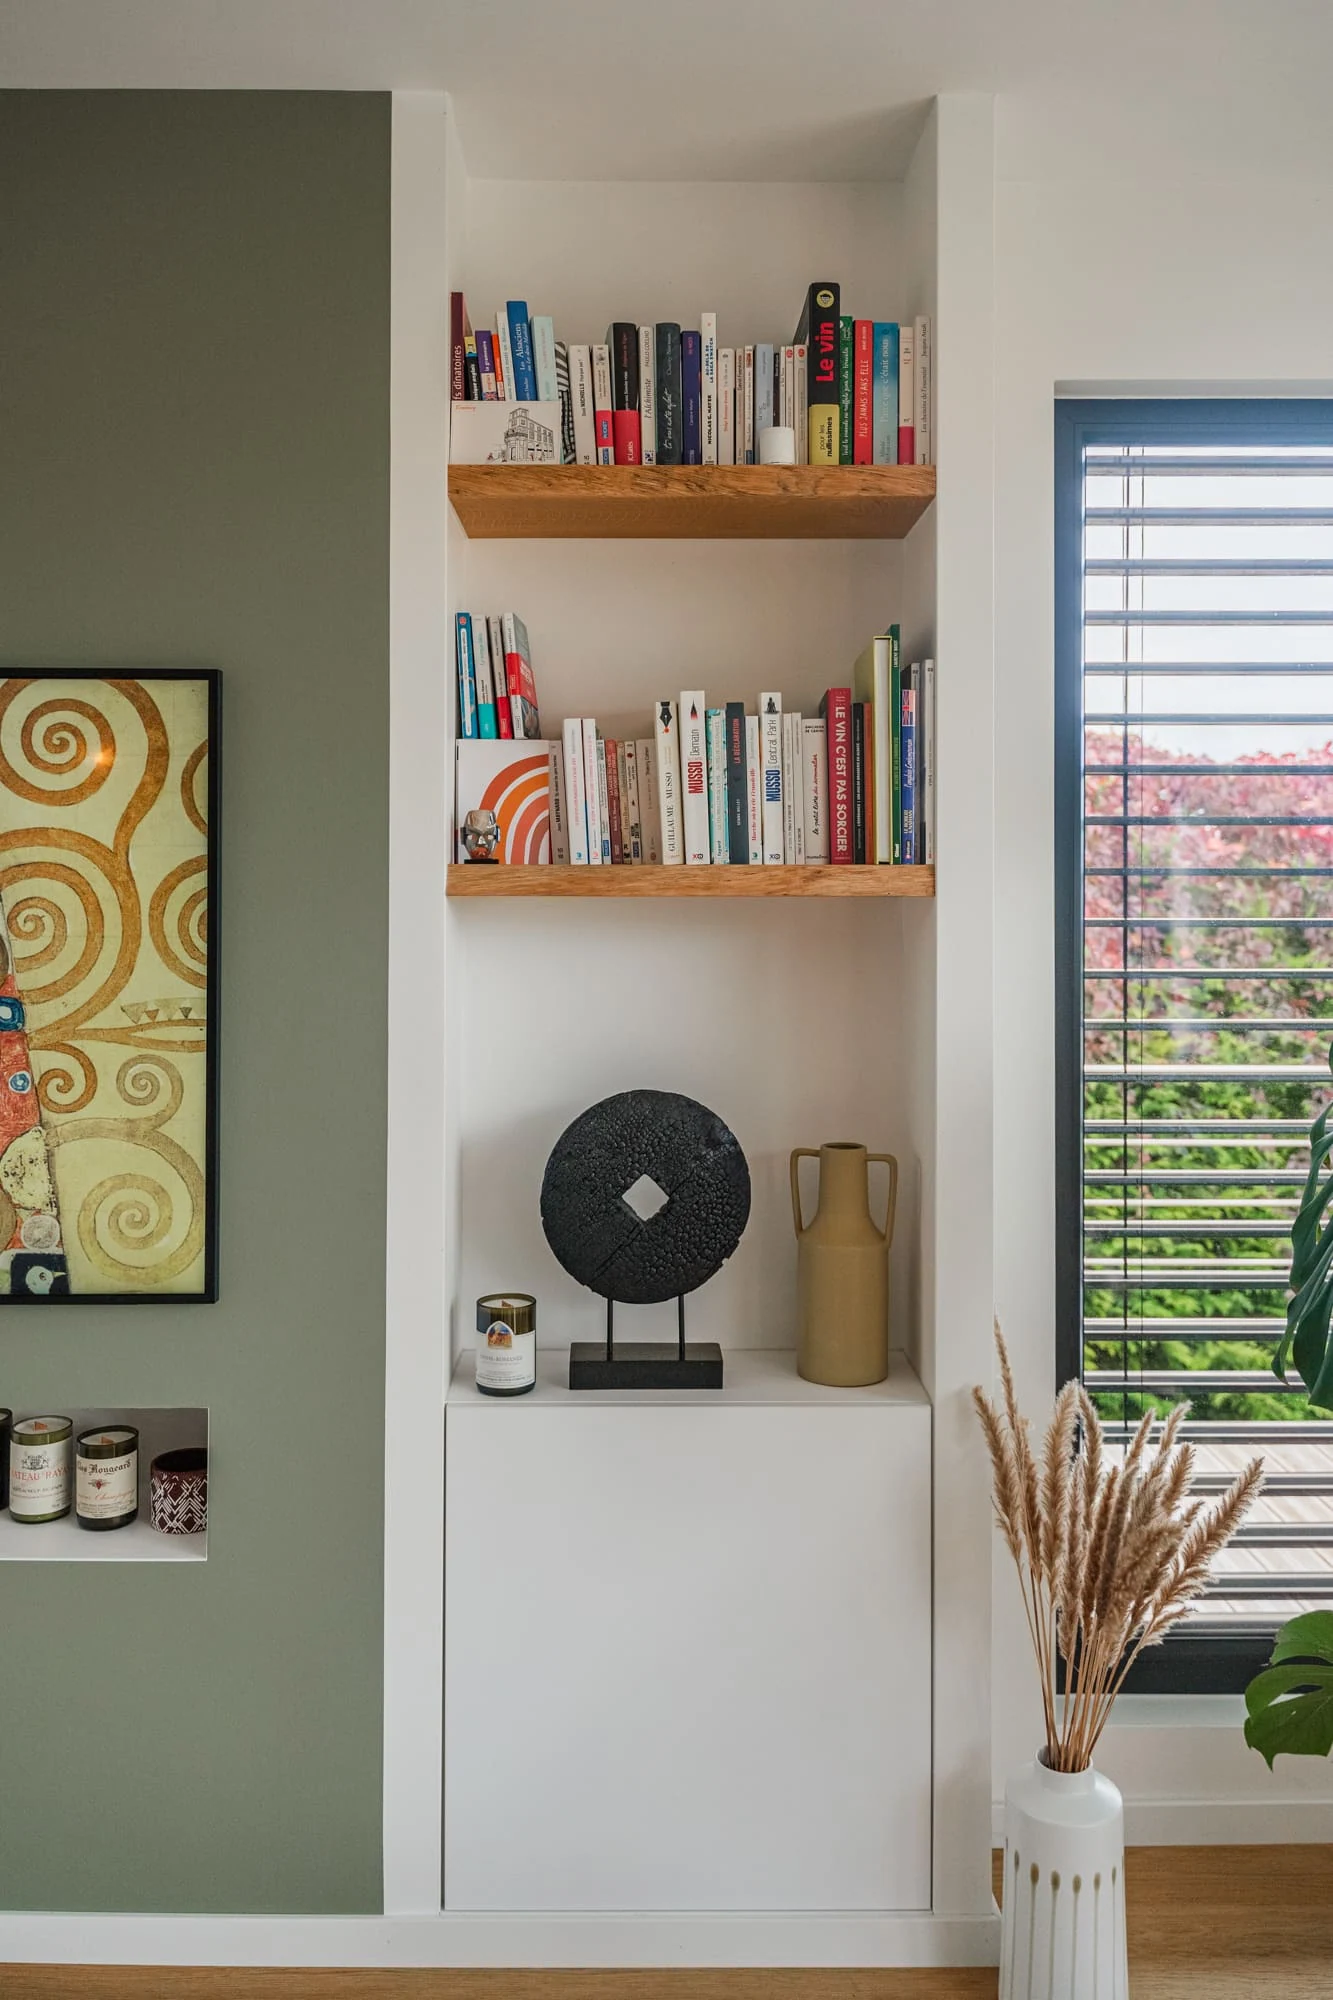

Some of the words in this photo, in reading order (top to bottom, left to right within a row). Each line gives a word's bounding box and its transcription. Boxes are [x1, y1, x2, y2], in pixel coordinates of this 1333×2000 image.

[515, 323, 523, 358] Alsaciens
[814, 322, 835, 353] vin
[454, 345, 462, 390] dînatoires
[815, 359, 835, 381] Le
[860, 359, 868, 375] ELLE
[880, 360, 889, 384] c'était
[860, 377, 868, 395] SANS
[644, 378, 652, 419] l'Alchimiste
[860, 397, 868, 421] JAMAIS
[859, 423, 868, 437] PLUS
[819, 437, 827, 451] pour
[835, 707, 846, 719] LE
[732, 718, 740, 756] DÉCLARATION
[767, 719, 777, 736] Park
[835, 721, 846, 743] VIN
[689, 728, 702, 757] Demain
[767, 738, 777, 764] Central
[734, 756, 740, 764] LA
[835, 745, 847, 777] C'EST
[665, 771, 673, 799] MUSSO
[687, 761, 704, 794] MUSSO
[765, 769, 781, 802] MUSSO
[812, 784, 818, 794] du
[836, 779, 847, 801] PAS
[667, 805, 675, 852] GUILLAUME
[812, 827, 819, 835] le
[836, 804, 848, 853] SORCIER
[88, 1459, 132, 1476] Rougeard
